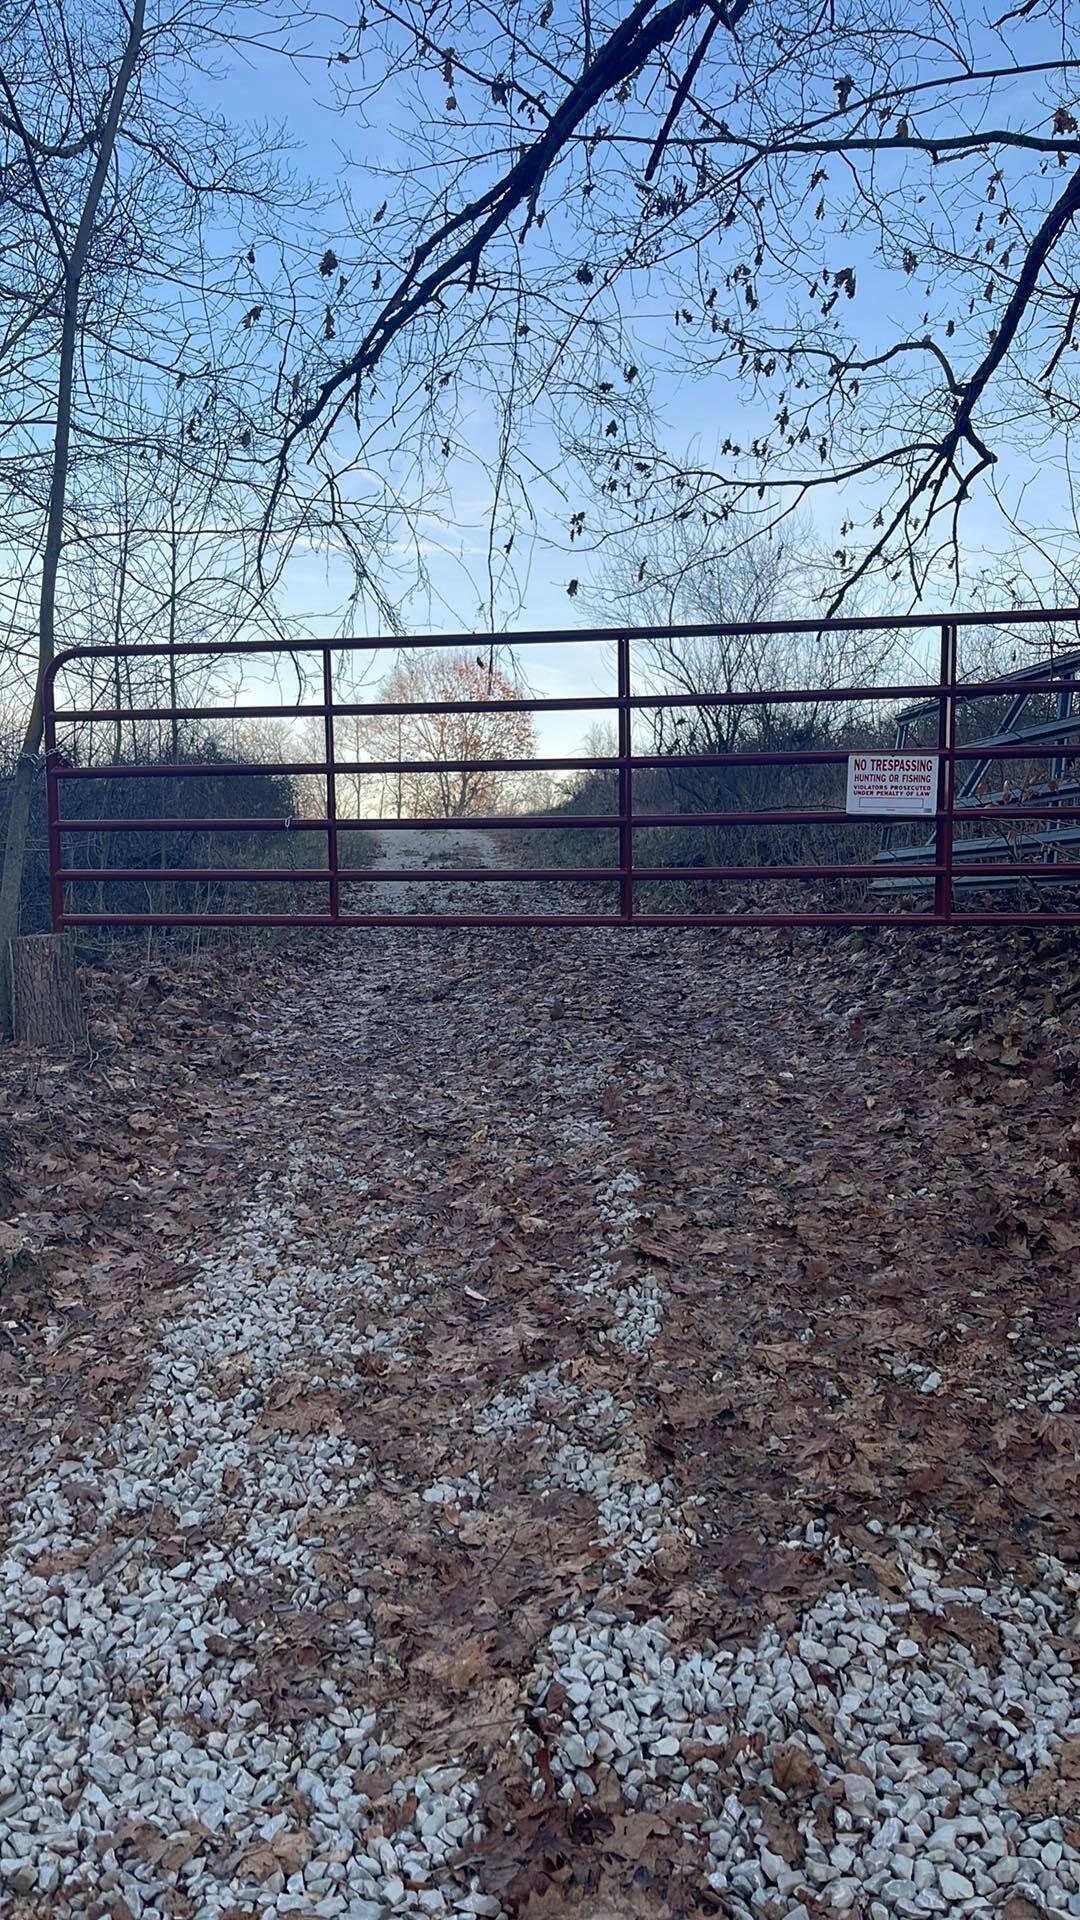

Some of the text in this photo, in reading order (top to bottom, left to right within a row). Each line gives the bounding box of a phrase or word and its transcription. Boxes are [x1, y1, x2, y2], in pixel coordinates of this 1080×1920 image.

[854, 759, 932, 772] NO TRESPASSING
[854, 774, 931, 783] HUNTING OR FISHING
